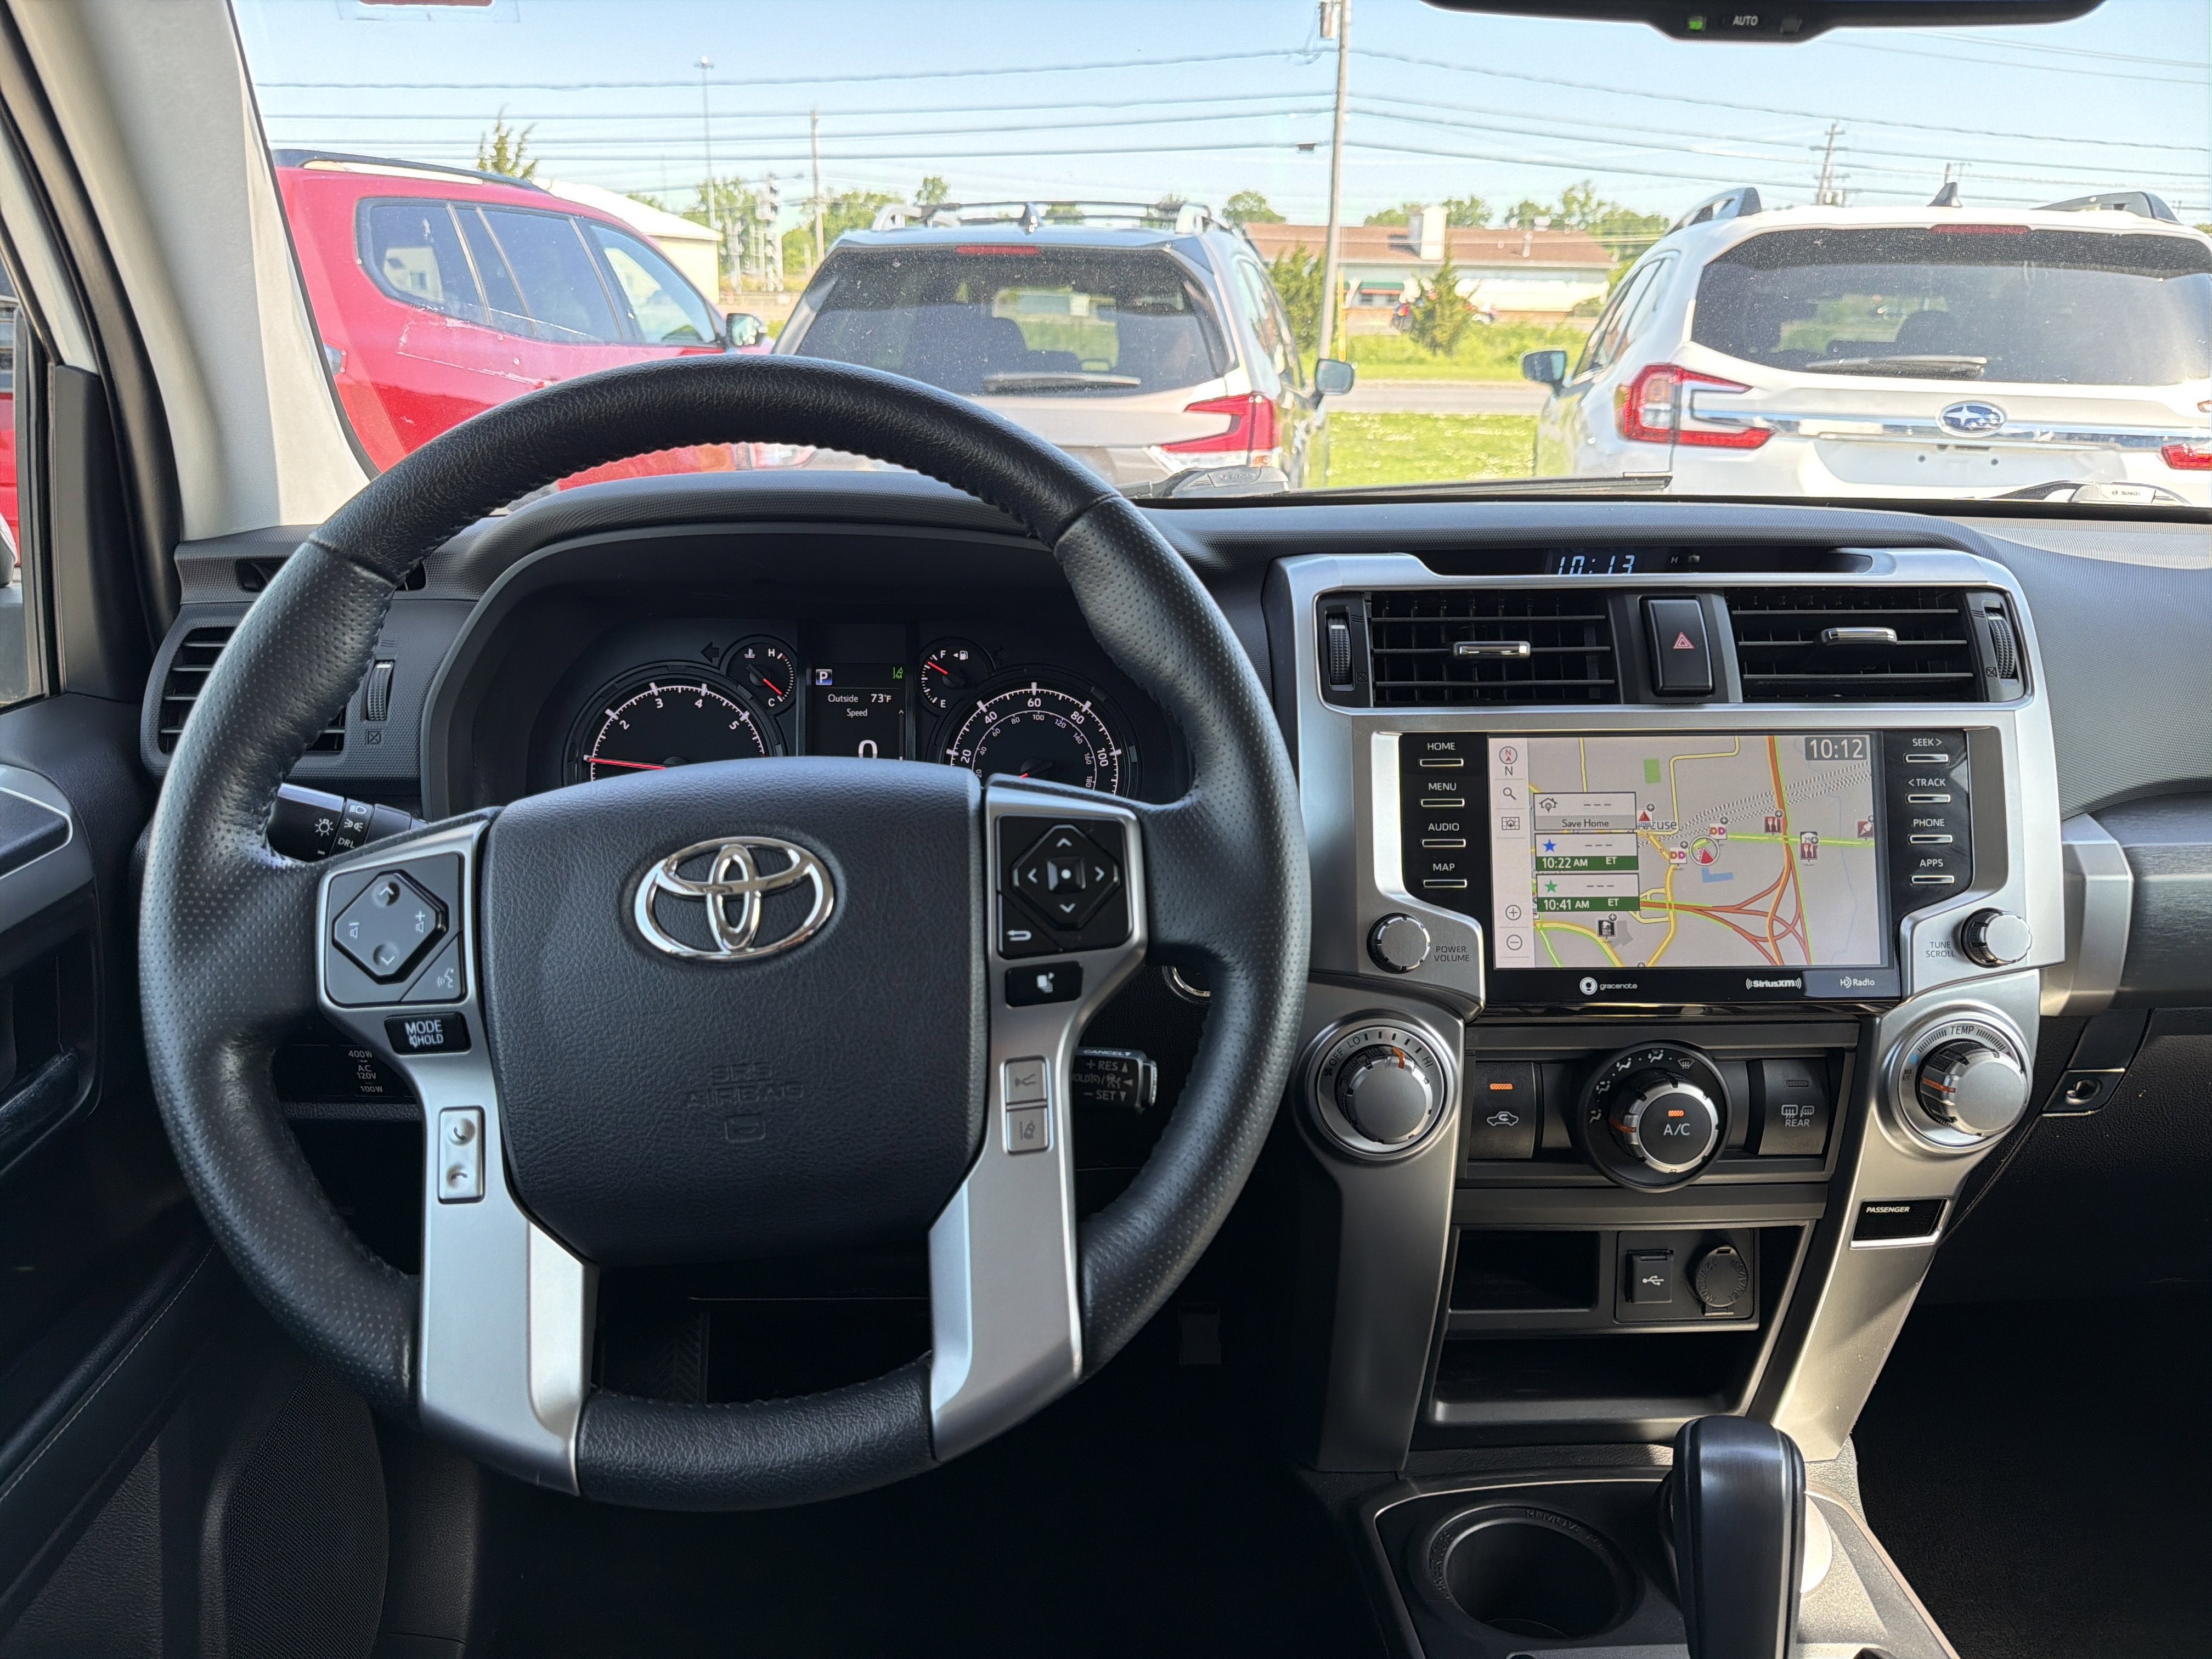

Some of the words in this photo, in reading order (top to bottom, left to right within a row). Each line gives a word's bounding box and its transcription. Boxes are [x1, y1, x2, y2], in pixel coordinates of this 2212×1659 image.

[1732, 15, 1759, 26] AUTO
[1558, 555, 1635, 575] 10:13
[768, 648, 775, 657] H
[819, 672, 828, 684] P
[695, 699, 703, 708] 4
[768, 698, 775, 707] C
[828, 694, 859, 703] Outside
[1028, 698, 1041, 707] 60
[654, 699, 663, 709] 3
[847, 709, 868, 718] Speed
[984, 711, 997, 724] 40
[1070, 712, 1085, 724] 80
[619, 720, 630, 730] 2
[729, 720, 740, 730] 5
[1011, 716, 1020, 725] 80
[1054, 719, 1066, 729] 120
[992, 728, 1001, 737] 60
[1073, 732, 1083, 744] 140
[980, 746, 987, 755] 40
[1427, 742, 1455, 751] HOME
[1810, 739, 1864, 759] 10:12
[960, 749, 972, 763] 20
[1084, 753, 1092, 765] 160
[1097, 747, 1109, 767] 100
[1505, 766, 1513, 776] N
[1428, 782, 1457, 791] MENU
[1428, 823, 1459, 831] AUDIO
[1562, 819, 1581, 828] Save
[1584, 819, 1609, 827] Home
[1913, 819, 1945, 827] PHONE
[338, 837, 356, 849] DRL
[1432, 863, 1455, 871] MAP
[1542, 857, 1571, 868] 10:22
[1920, 859, 1943, 867] APPS
[1544, 899, 1571, 910] 10:41
[1575, 900, 1589, 909] AM
[1599, 982, 1637, 990] gracenote
[1853, 978, 1875, 986] Radio
[405, 1020, 442, 1035] MODE
[1950, 1025, 1974, 1035] TEMP
[417, 1034, 444, 1045] HOLD
[1347, 1036, 1361, 1048] LO
[348, 1050, 373, 1058] 400W
[1329, 1047, 1344, 1066] OFF
[1421, 1057, 1434, 1068] HI
[1073, 1073, 1090, 1082] OLD
[1785, 1119, 1810, 1127] REAR
[1663, 1123, 1690, 1136] A/C
